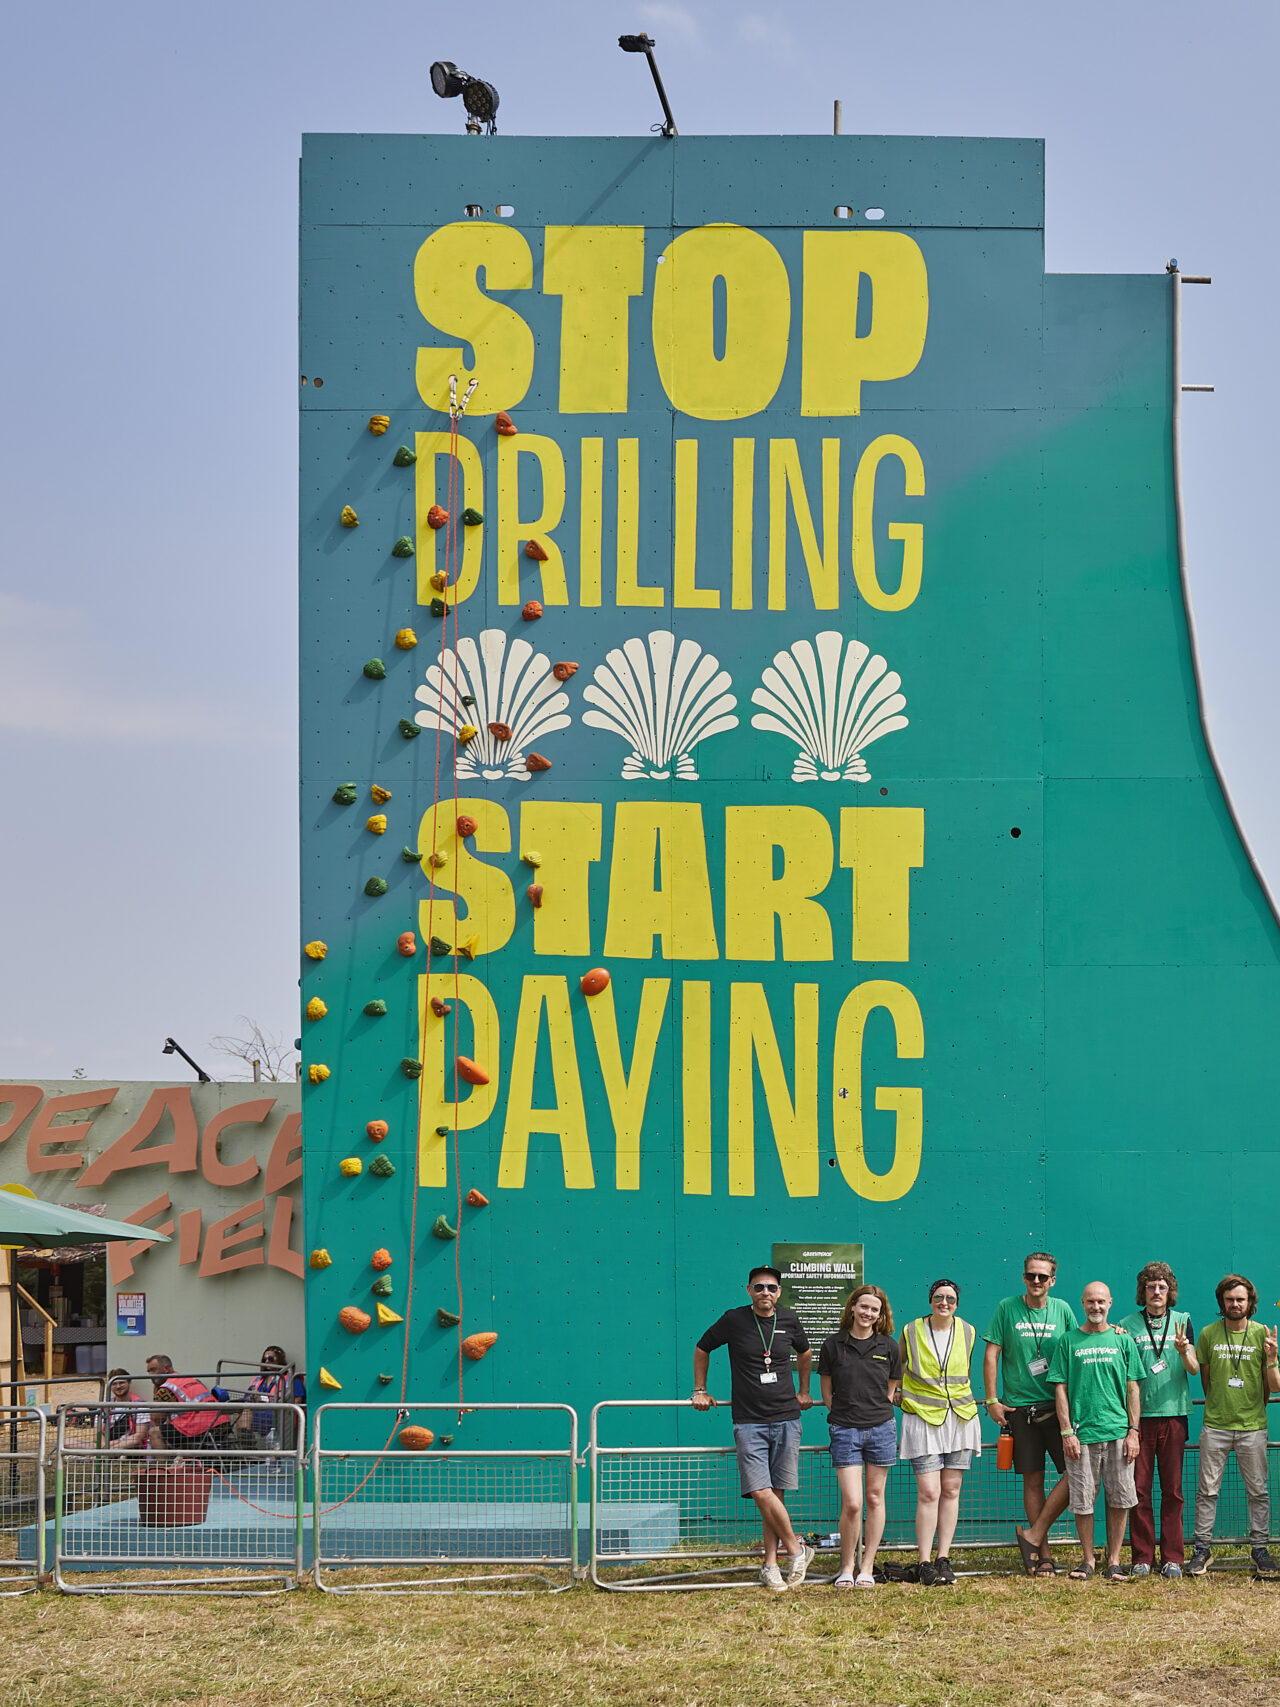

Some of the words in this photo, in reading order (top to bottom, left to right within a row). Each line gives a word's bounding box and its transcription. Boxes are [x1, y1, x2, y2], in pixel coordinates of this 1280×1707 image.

[414, 221, 929, 421] STOP
[414, 431, 926, 612] DRILLING
[417, 798, 925, 962] START
[417, 973, 925, 1202] PAYING
[790, 1263, 831, 1273] CLIMBING
[833, 1263, 856, 1273] WALL
[1075, 1347, 1119, 1358] GREENPEACE
